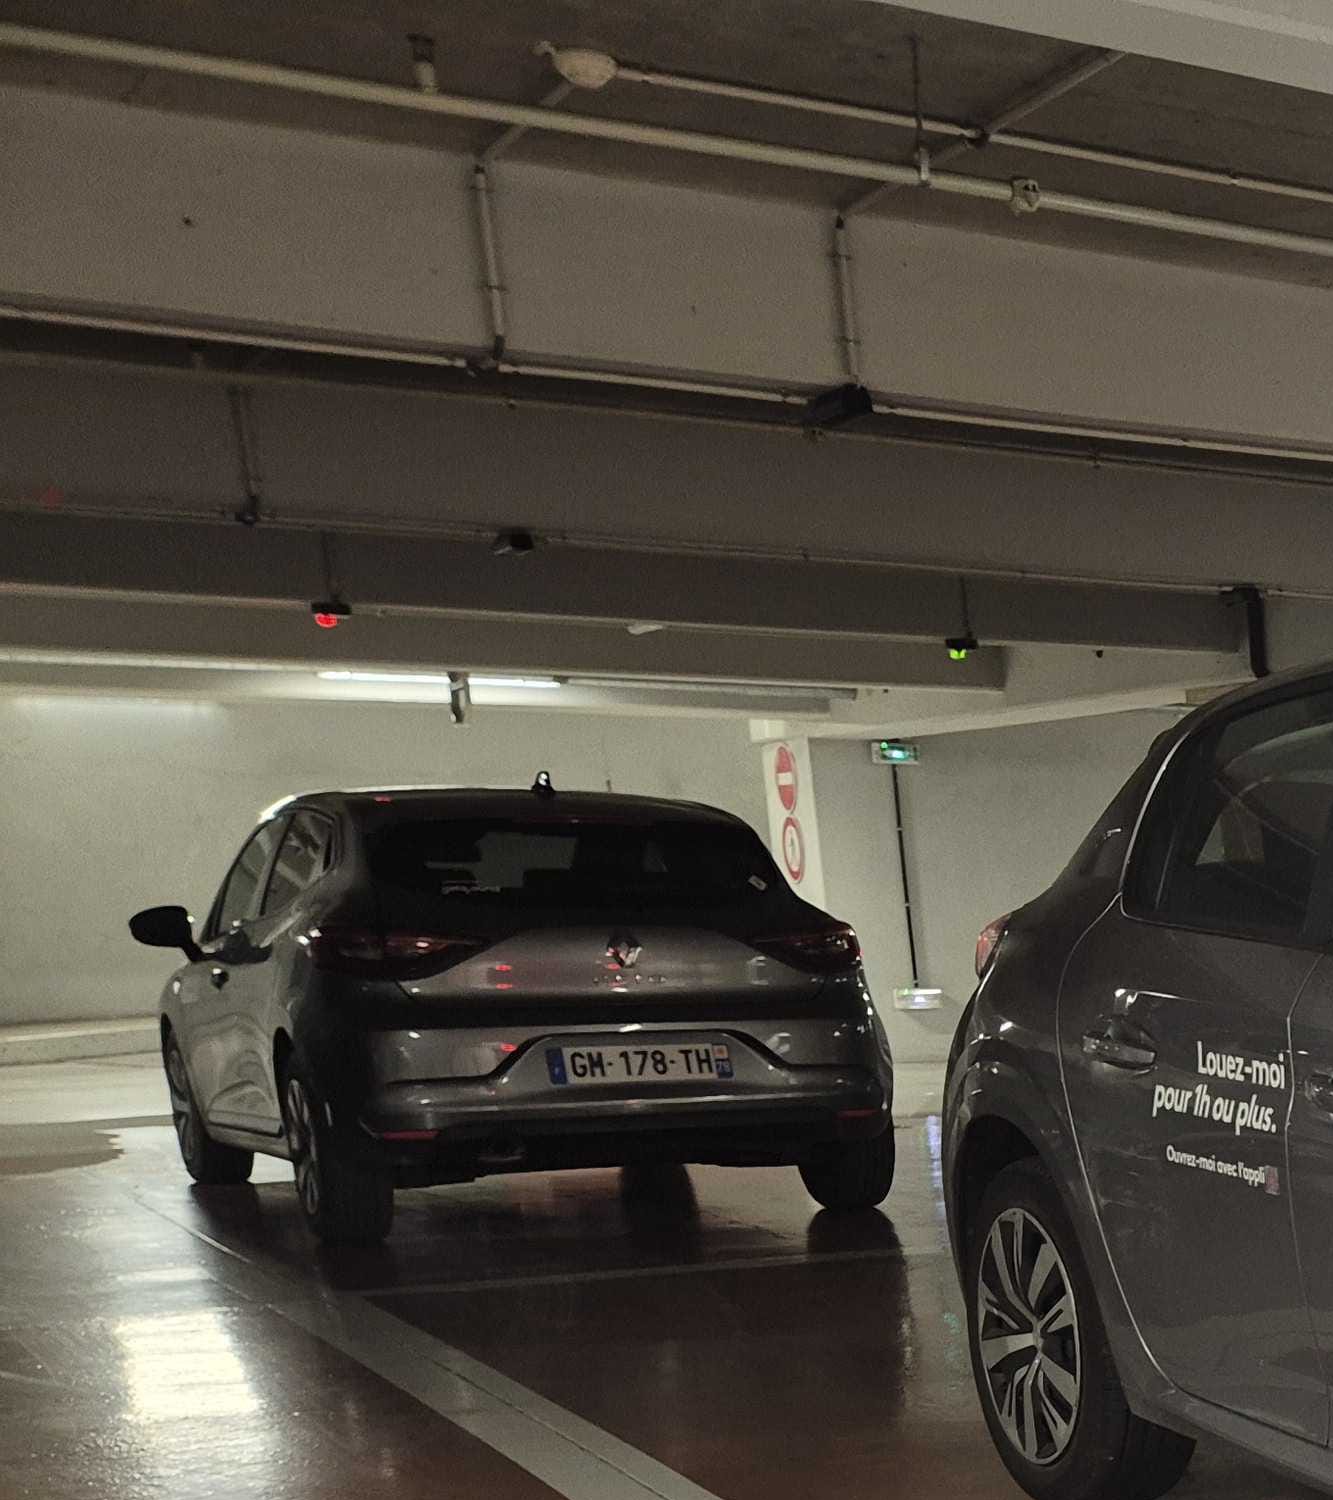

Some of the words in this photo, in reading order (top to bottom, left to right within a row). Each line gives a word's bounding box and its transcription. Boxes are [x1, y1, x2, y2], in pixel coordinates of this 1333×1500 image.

[1196, 1040, 1285, 1089] Louez-moi
[1152, 1084, 1192, 1117] pour
[1193, 1083, 1211, 1119] 1h
[1212, 1097, 1235, 1123] ou
[1235, 1094, 1277, 1136] plus.
[1166, 1144, 1216, 1172] Ouvrez-moi
[1217, 1161, 1238, 1177] avec
[1238, 1161, 1265, 1187] l'appli
